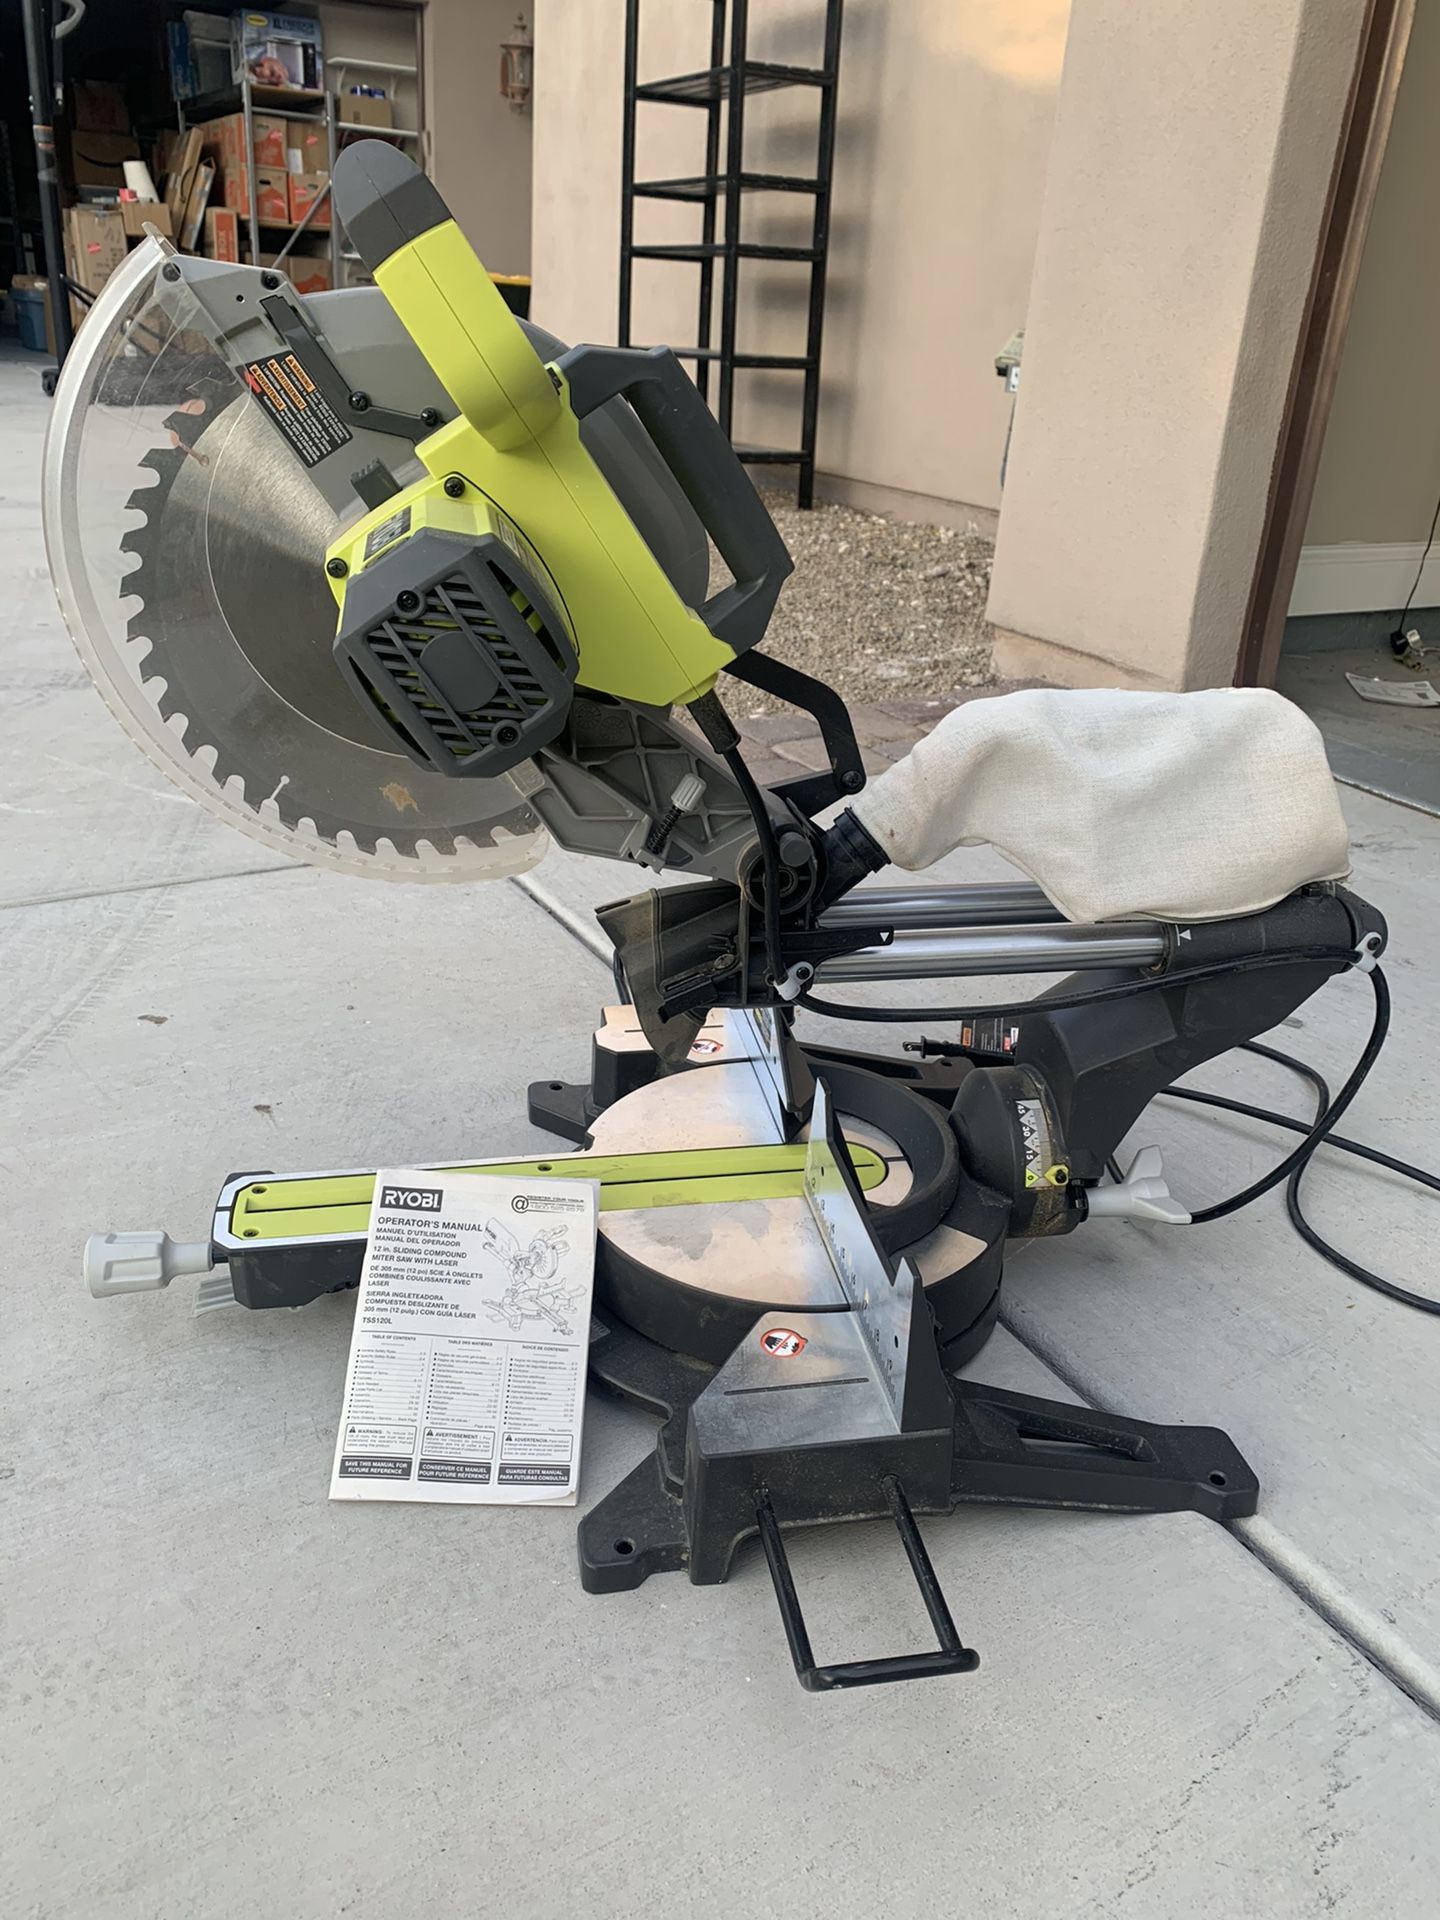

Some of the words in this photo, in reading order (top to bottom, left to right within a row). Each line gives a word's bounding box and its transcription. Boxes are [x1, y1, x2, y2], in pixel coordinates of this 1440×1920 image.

[292, 363, 312, 389] WARNING
[256, 372, 284, 408] ADVERTENCIA
[1017, 1104, 1026, 1115] 45
[1022, 1126, 1031, 1137] 30
[1025, 1150, 1034, 1160] 15
[385, 1190, 439, 1208] RYOBI
[378, 1216, 440, 1229] OPERATOR'S
[442, 1222, 483, 1232] MANUAL
[376, 1227, 406, 1235] MANUEL
[407, 1229, 457, 1239] D'UTILISATION
[375, 1235, 404, 1243] MANUAL
[421, 1238, 461, 1247] OPERADOR
[393, 1246, 422, 1255] SLIDING
[423, 1249, 467, 1259] COMPOUND
[372, 1254, 395, 1262] MITER
[396, 1255, 413, 1263] SAW
[414, 1257, 433, 1265] WITH
[434, 1258, 458, 1267] LASER
[405, 1274, 452, 1284] COULISSANTE
[453, 1278, 471, 1286] AVEC
[451, 1271, 483, 1279] ONGLETS
[392, 1291, 444, 1301] INGLETEADORA
[365, 1298, 407, 1306] COMPUESTA
[407, 1300, 449, 1309] DESLIZANTE
[362, 1316, 393, 1325] TSS120L
